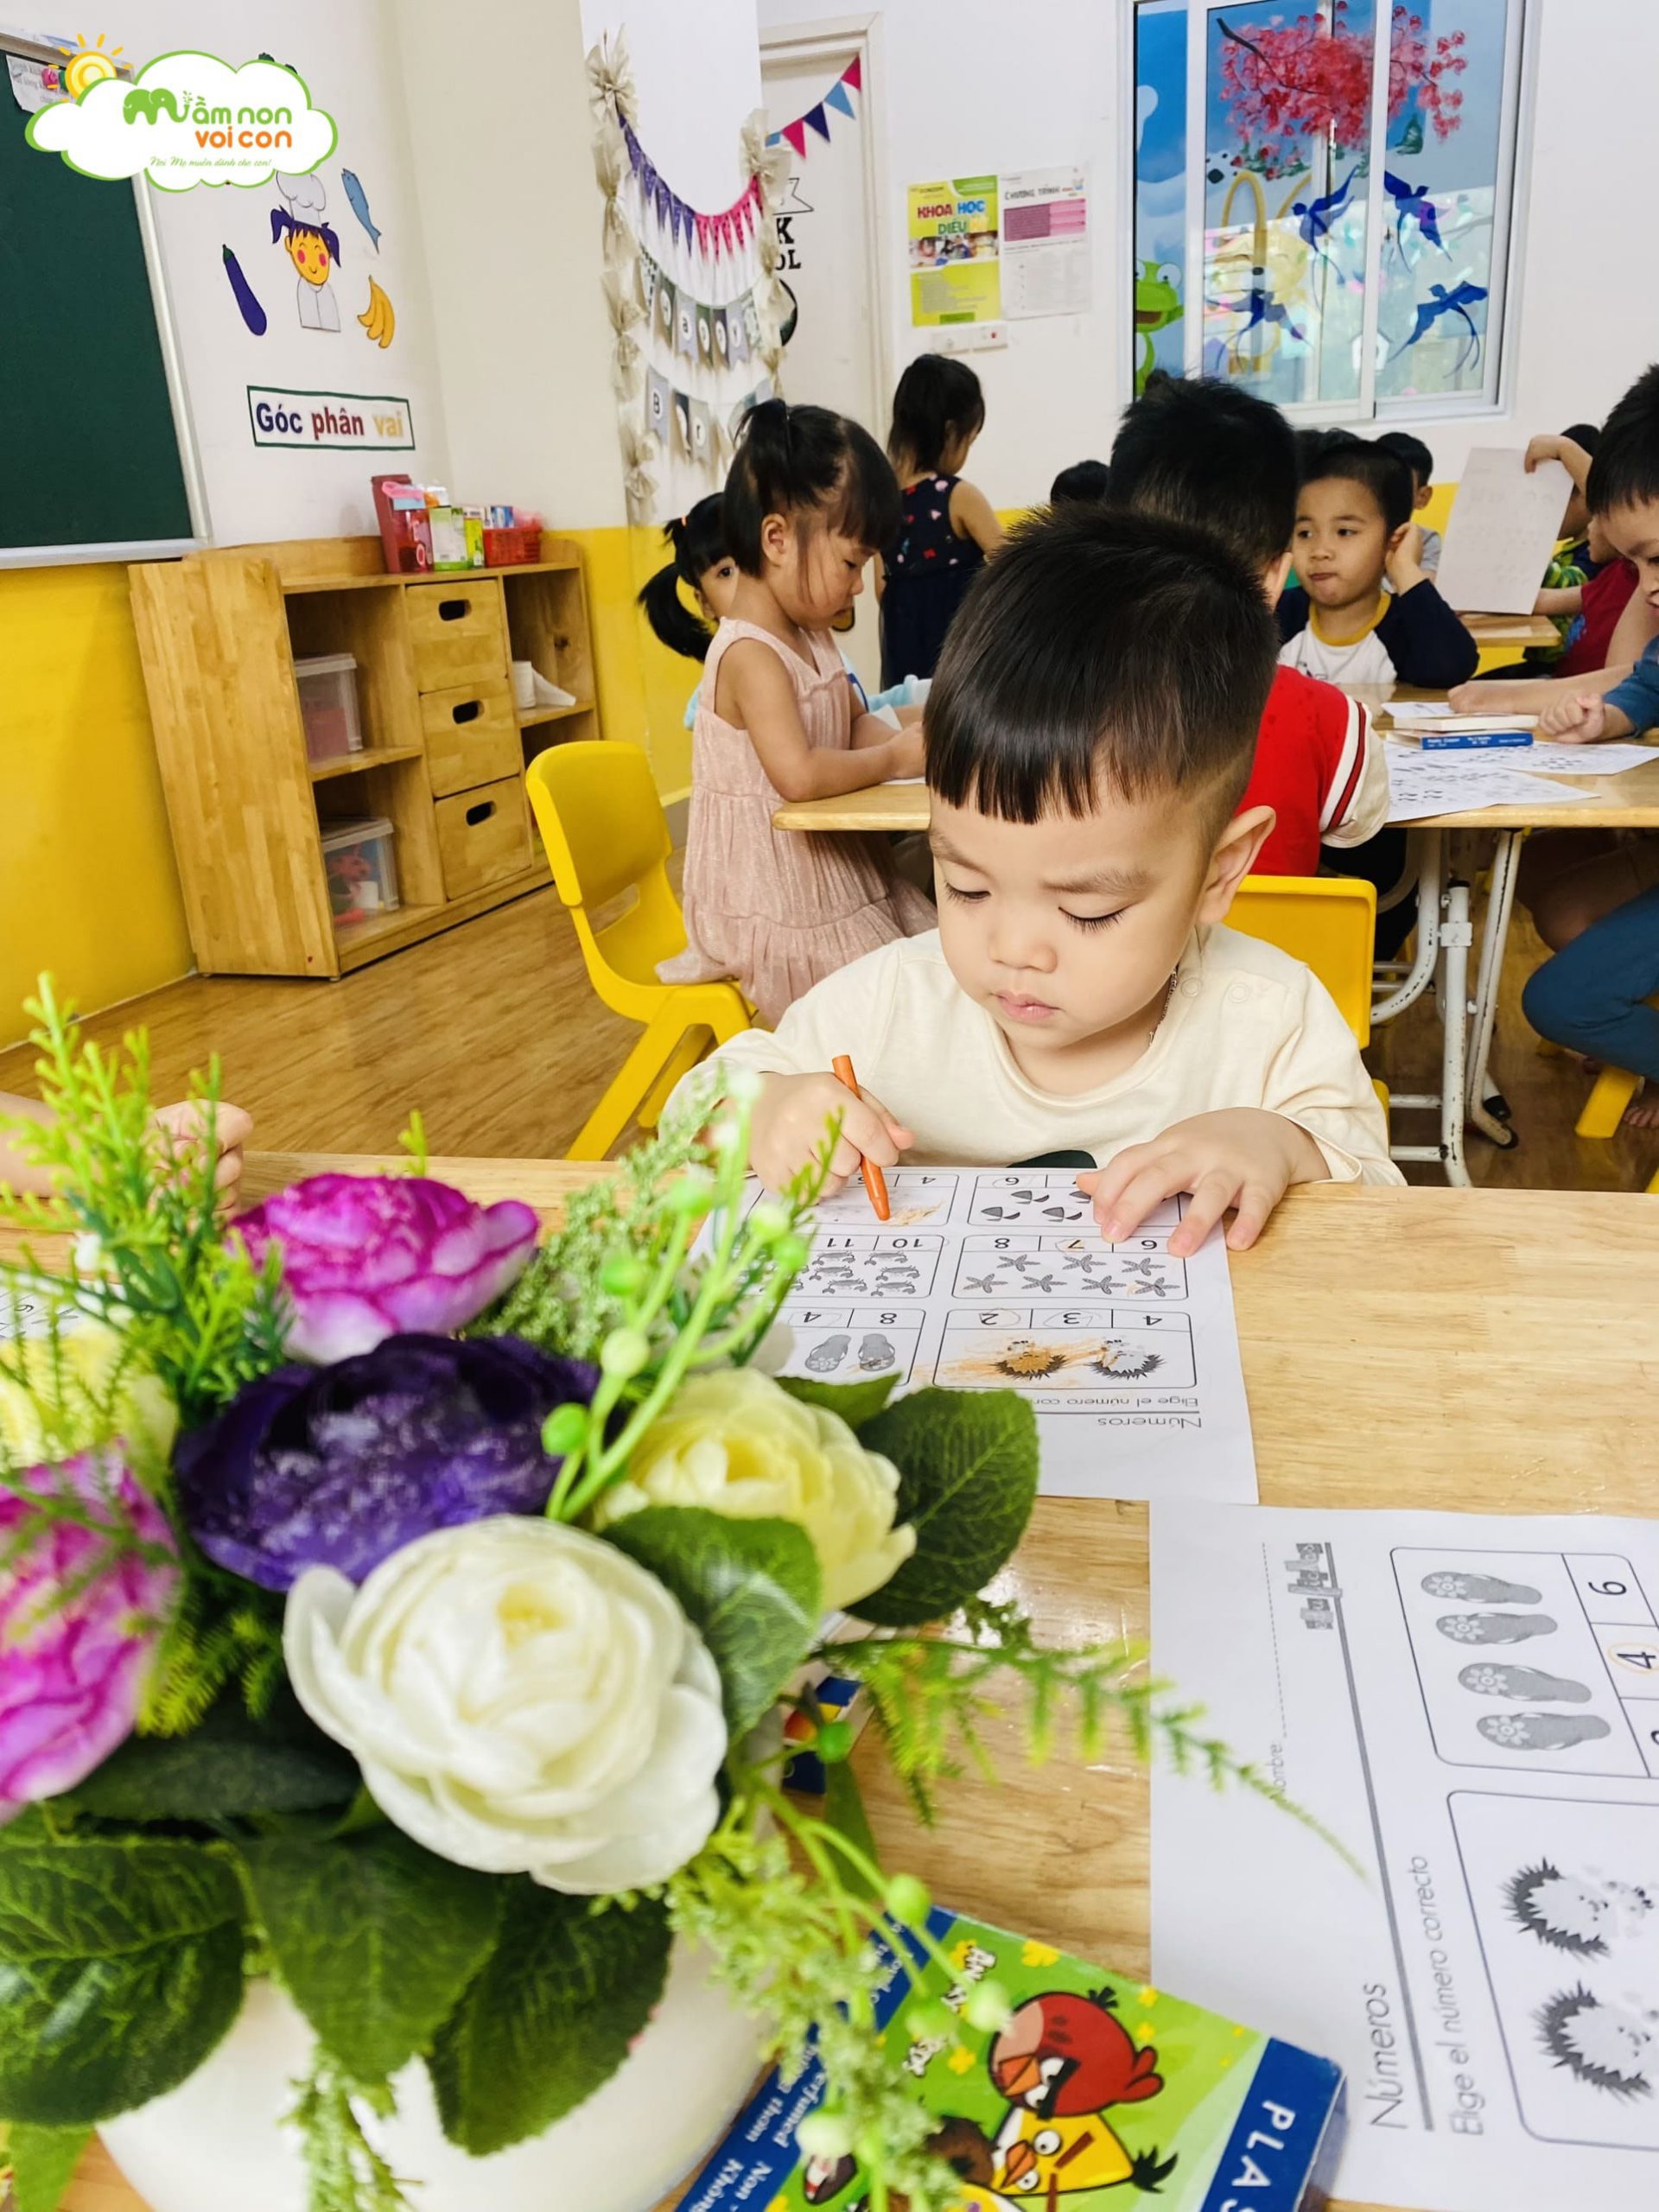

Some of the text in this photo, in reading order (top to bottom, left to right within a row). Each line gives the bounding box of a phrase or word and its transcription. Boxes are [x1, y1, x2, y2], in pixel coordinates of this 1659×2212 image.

[918, 203, 952, 219] KHOA
[256, 402, 404, 441] Góc phân vai
[826, 1236, 854, 1248] 11
[893, 1237, 924, 1249] 10
[995, 1237, 1011, 1249] 8
[804, 1312, 822, 1324] 4
[880, 1312, 898, 1325] 8
[981, 1312, 999, 1325] 2
[1063, 1312, 1081, 1325] 3
[1143, 1314, 1163, 1326] 4
[1137, 1396, 1152, 1408] el
[1157, 1395, 1198, 1408] Elige
[1097, 1416, 1202, 1429] Números
[1588, 1580, 1627, 1596] 6
[1616, 1651, 1656, 1670] 4
[1408, 1856, 1485, 2136] Elige el número correcto
[1363, 1982, 1408, 2130] Números
[735, 2071, 826, 2201] erfumed Non
